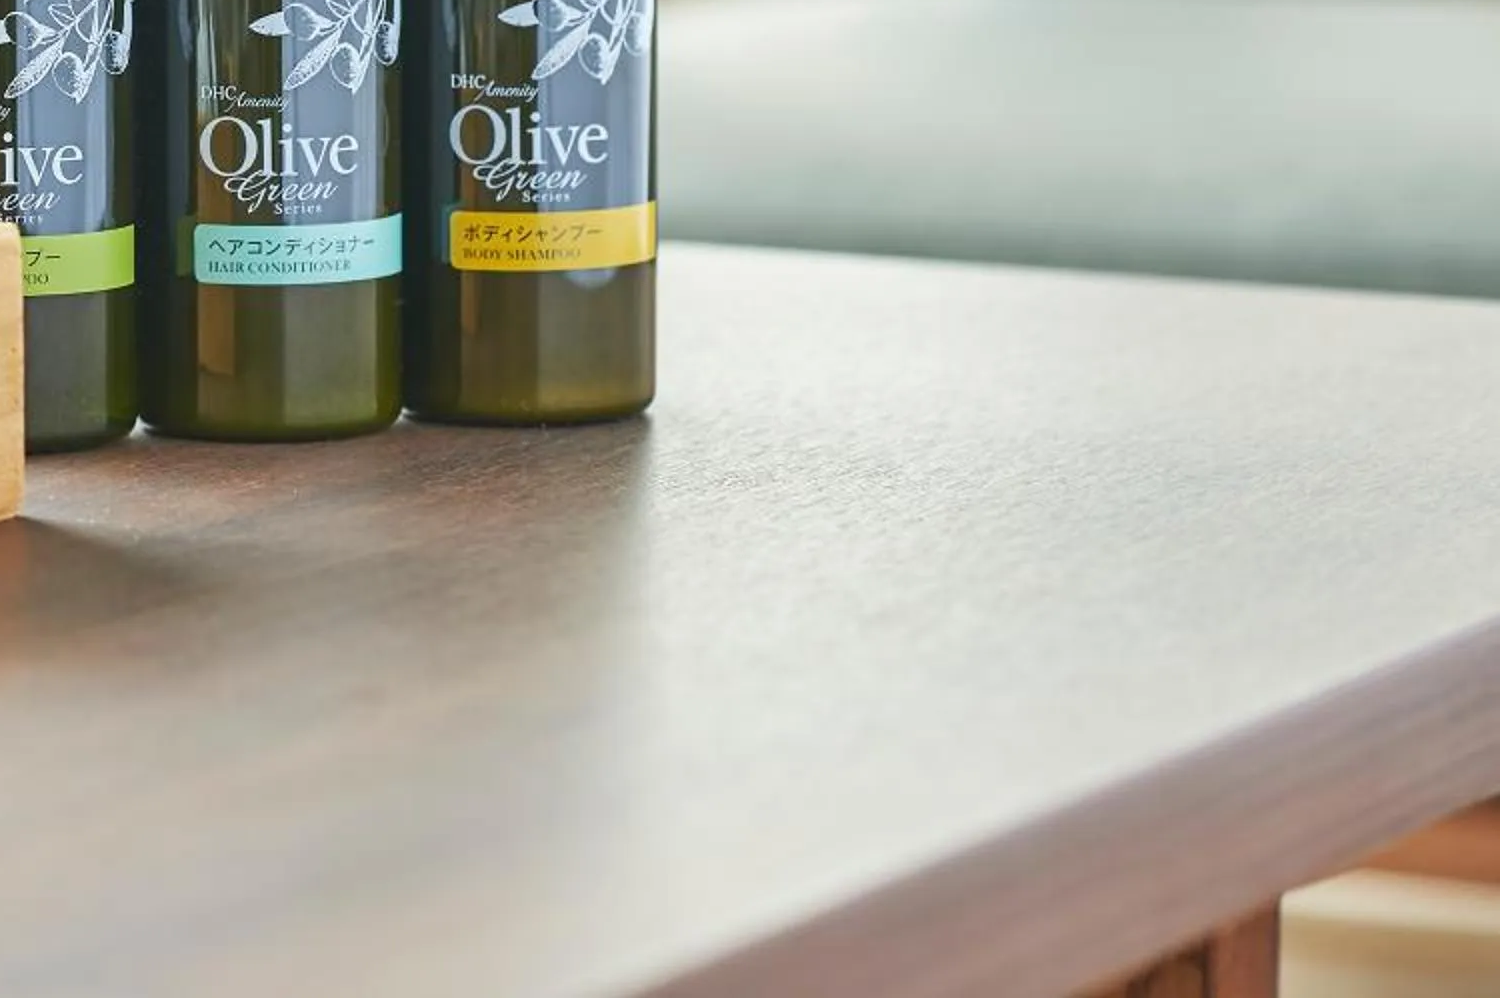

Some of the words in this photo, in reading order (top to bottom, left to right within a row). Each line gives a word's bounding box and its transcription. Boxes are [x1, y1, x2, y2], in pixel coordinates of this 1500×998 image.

[201, 85, 237, 101] DHC
[225, 92, 291, 113] Amenity
[451, 74, 487, 90] DHC
[475, 80, 540, 103] Amenity
[199, 115, 360, 178] Olive
[449, 103, 609, 167] Olive
[223, 168, 339, 215] Green
[472, 159, 587, 202] Green
[273, 202, 323, 215] Series
[521, 190, 571, 203] Series
[463, 222, 604, 243] ボディシャンプー
[208, 235, 375, 256] ヘアコンディショナー
[463, 248, 500, 261] BODY
[208, 260, 245, 275] HAIR
[247, 259, 352, 275] CONDITIONER
